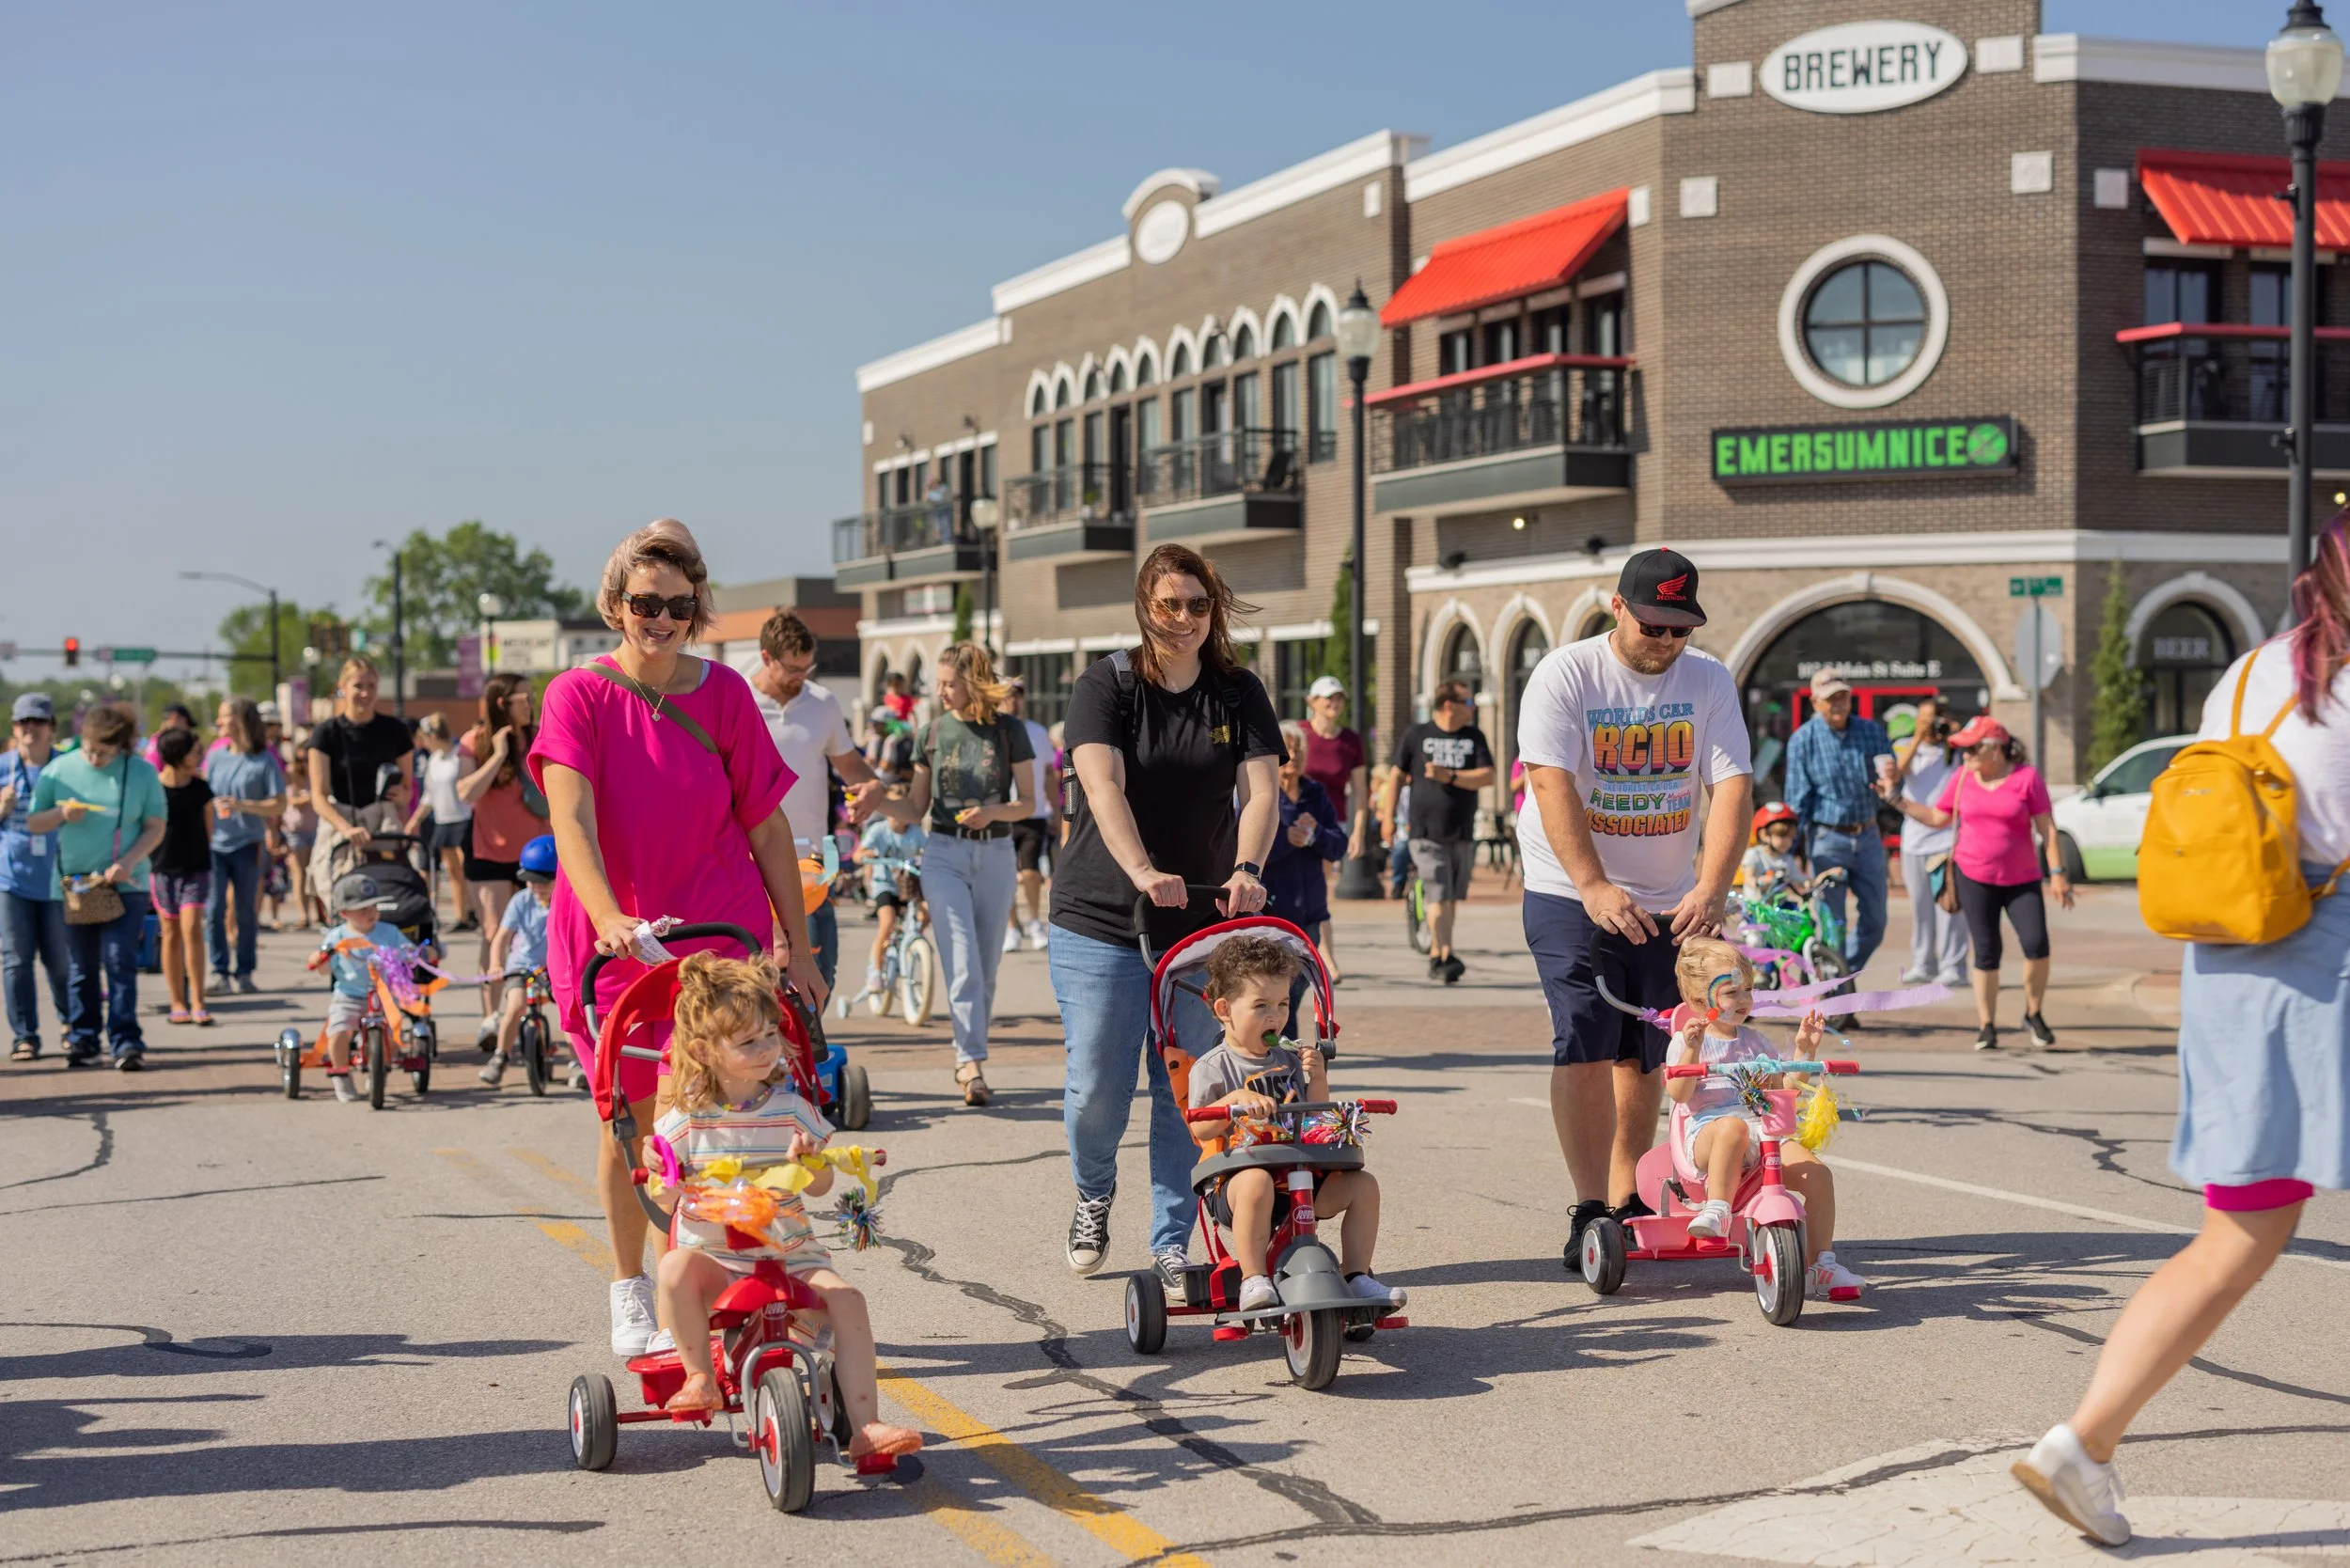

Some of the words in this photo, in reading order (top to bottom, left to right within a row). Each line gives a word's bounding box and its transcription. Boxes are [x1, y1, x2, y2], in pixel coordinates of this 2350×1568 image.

[1784, 40, 1943, 92] BREWERY
[1716, 426, 1968, 476] EMERSUMNICE
[1872, 660, 1888, 679] St
[1888, 660, 1926, 679] Suite
[1659, 702, 1694, 719] CAR
[1593, 720, 1694, 776] RC10
[1663, 781, 1678, 791] USA
[1590, 788, 1666, 811] REEDY
[1667, 795, 1691, 812] TEAM
[1586, 808, 1691, 837] ASSOCIATED
